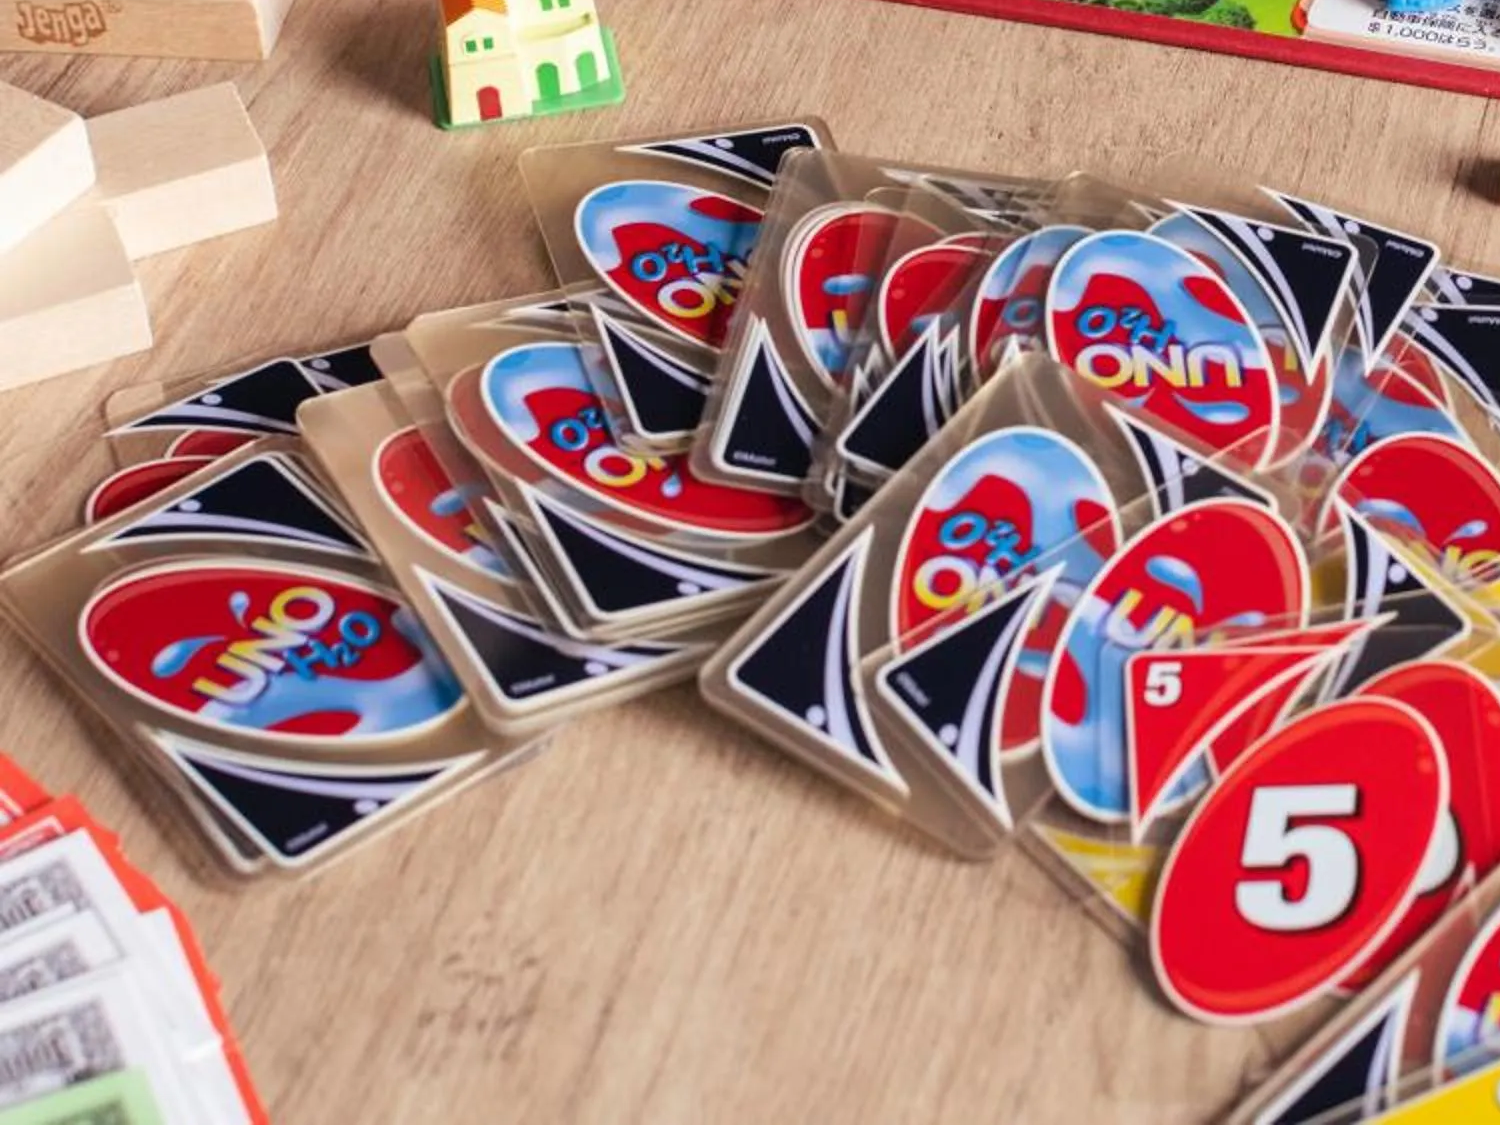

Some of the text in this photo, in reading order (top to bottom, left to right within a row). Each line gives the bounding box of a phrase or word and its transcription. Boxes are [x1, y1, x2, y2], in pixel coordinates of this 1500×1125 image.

[17, 0, 107, 46] Jenga
[1074, 342, 1243, 388] UNO
[192, 586, 336, 705] UNO
[1143, 661, 1183, 707] 5
[1233, 782, 1361, 933] 5
